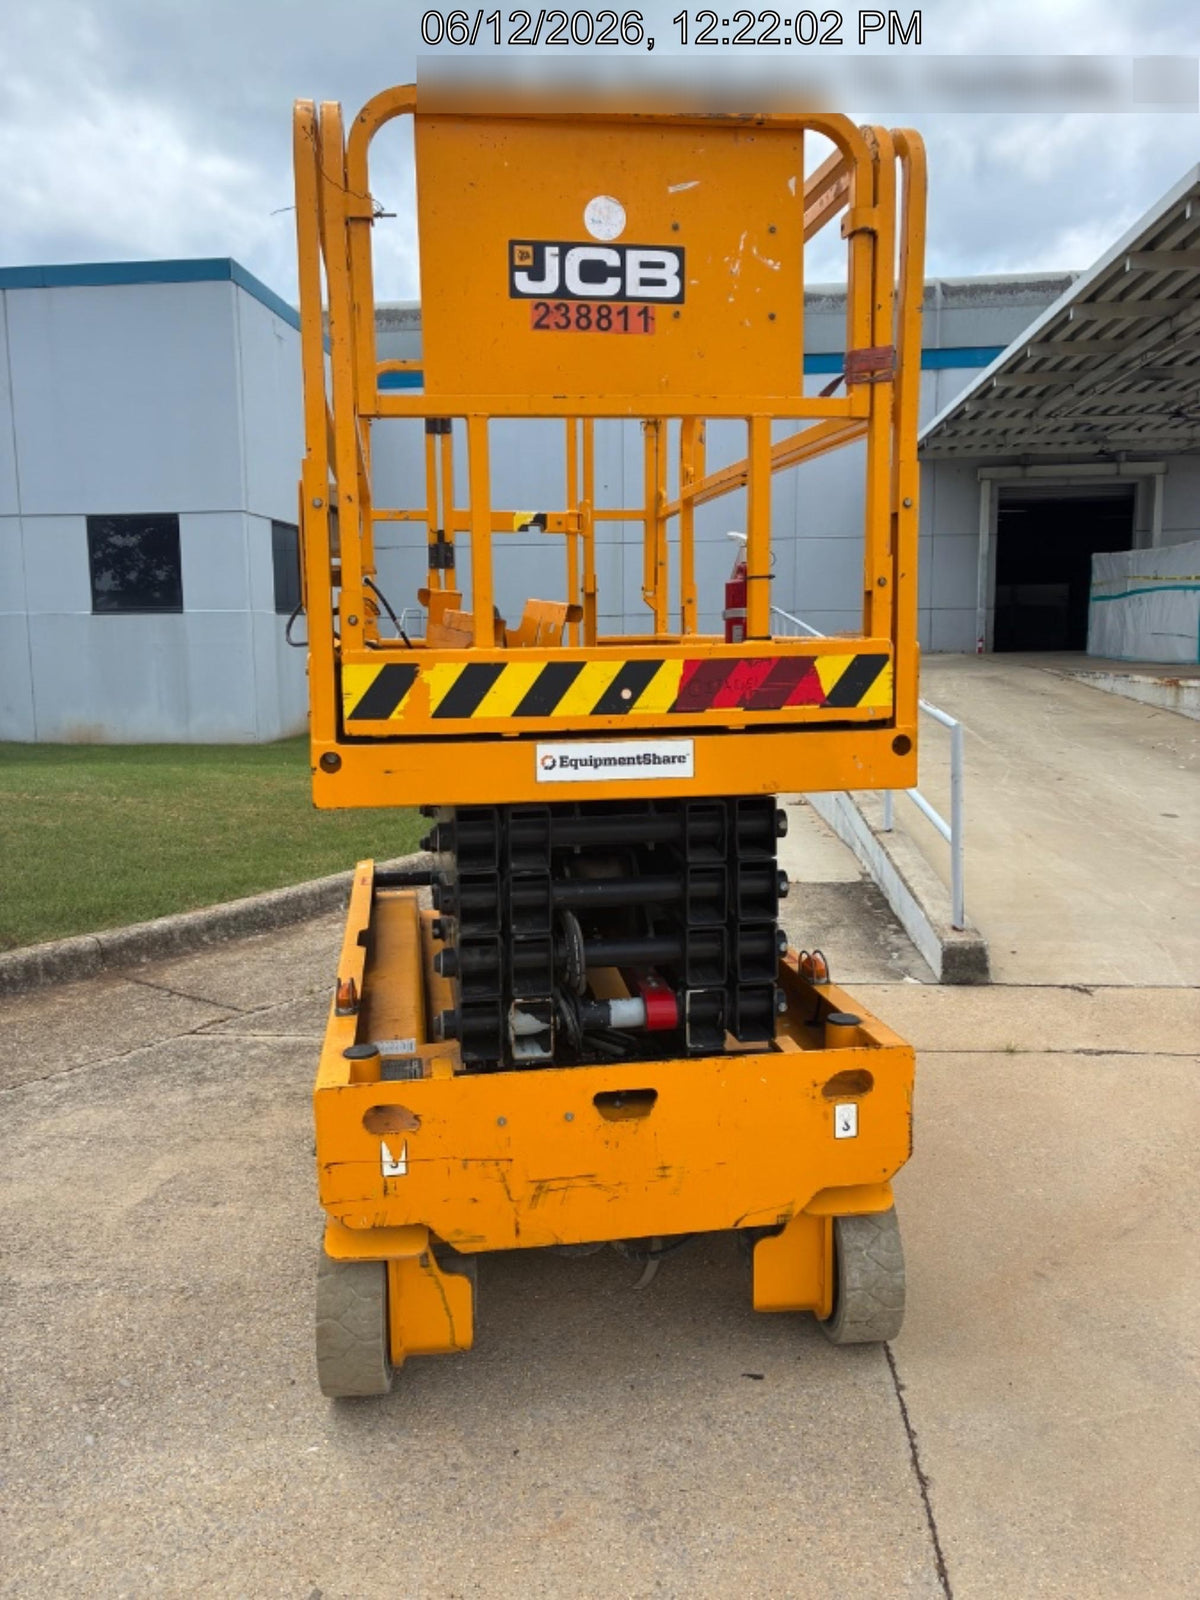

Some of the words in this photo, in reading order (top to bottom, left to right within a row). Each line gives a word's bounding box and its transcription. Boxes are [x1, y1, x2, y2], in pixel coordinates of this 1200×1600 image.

[514, 246, 681, 298] JCB
[533, 302, 653, 333] 238811
[559, 753, 687, 770] EquipmentShare
